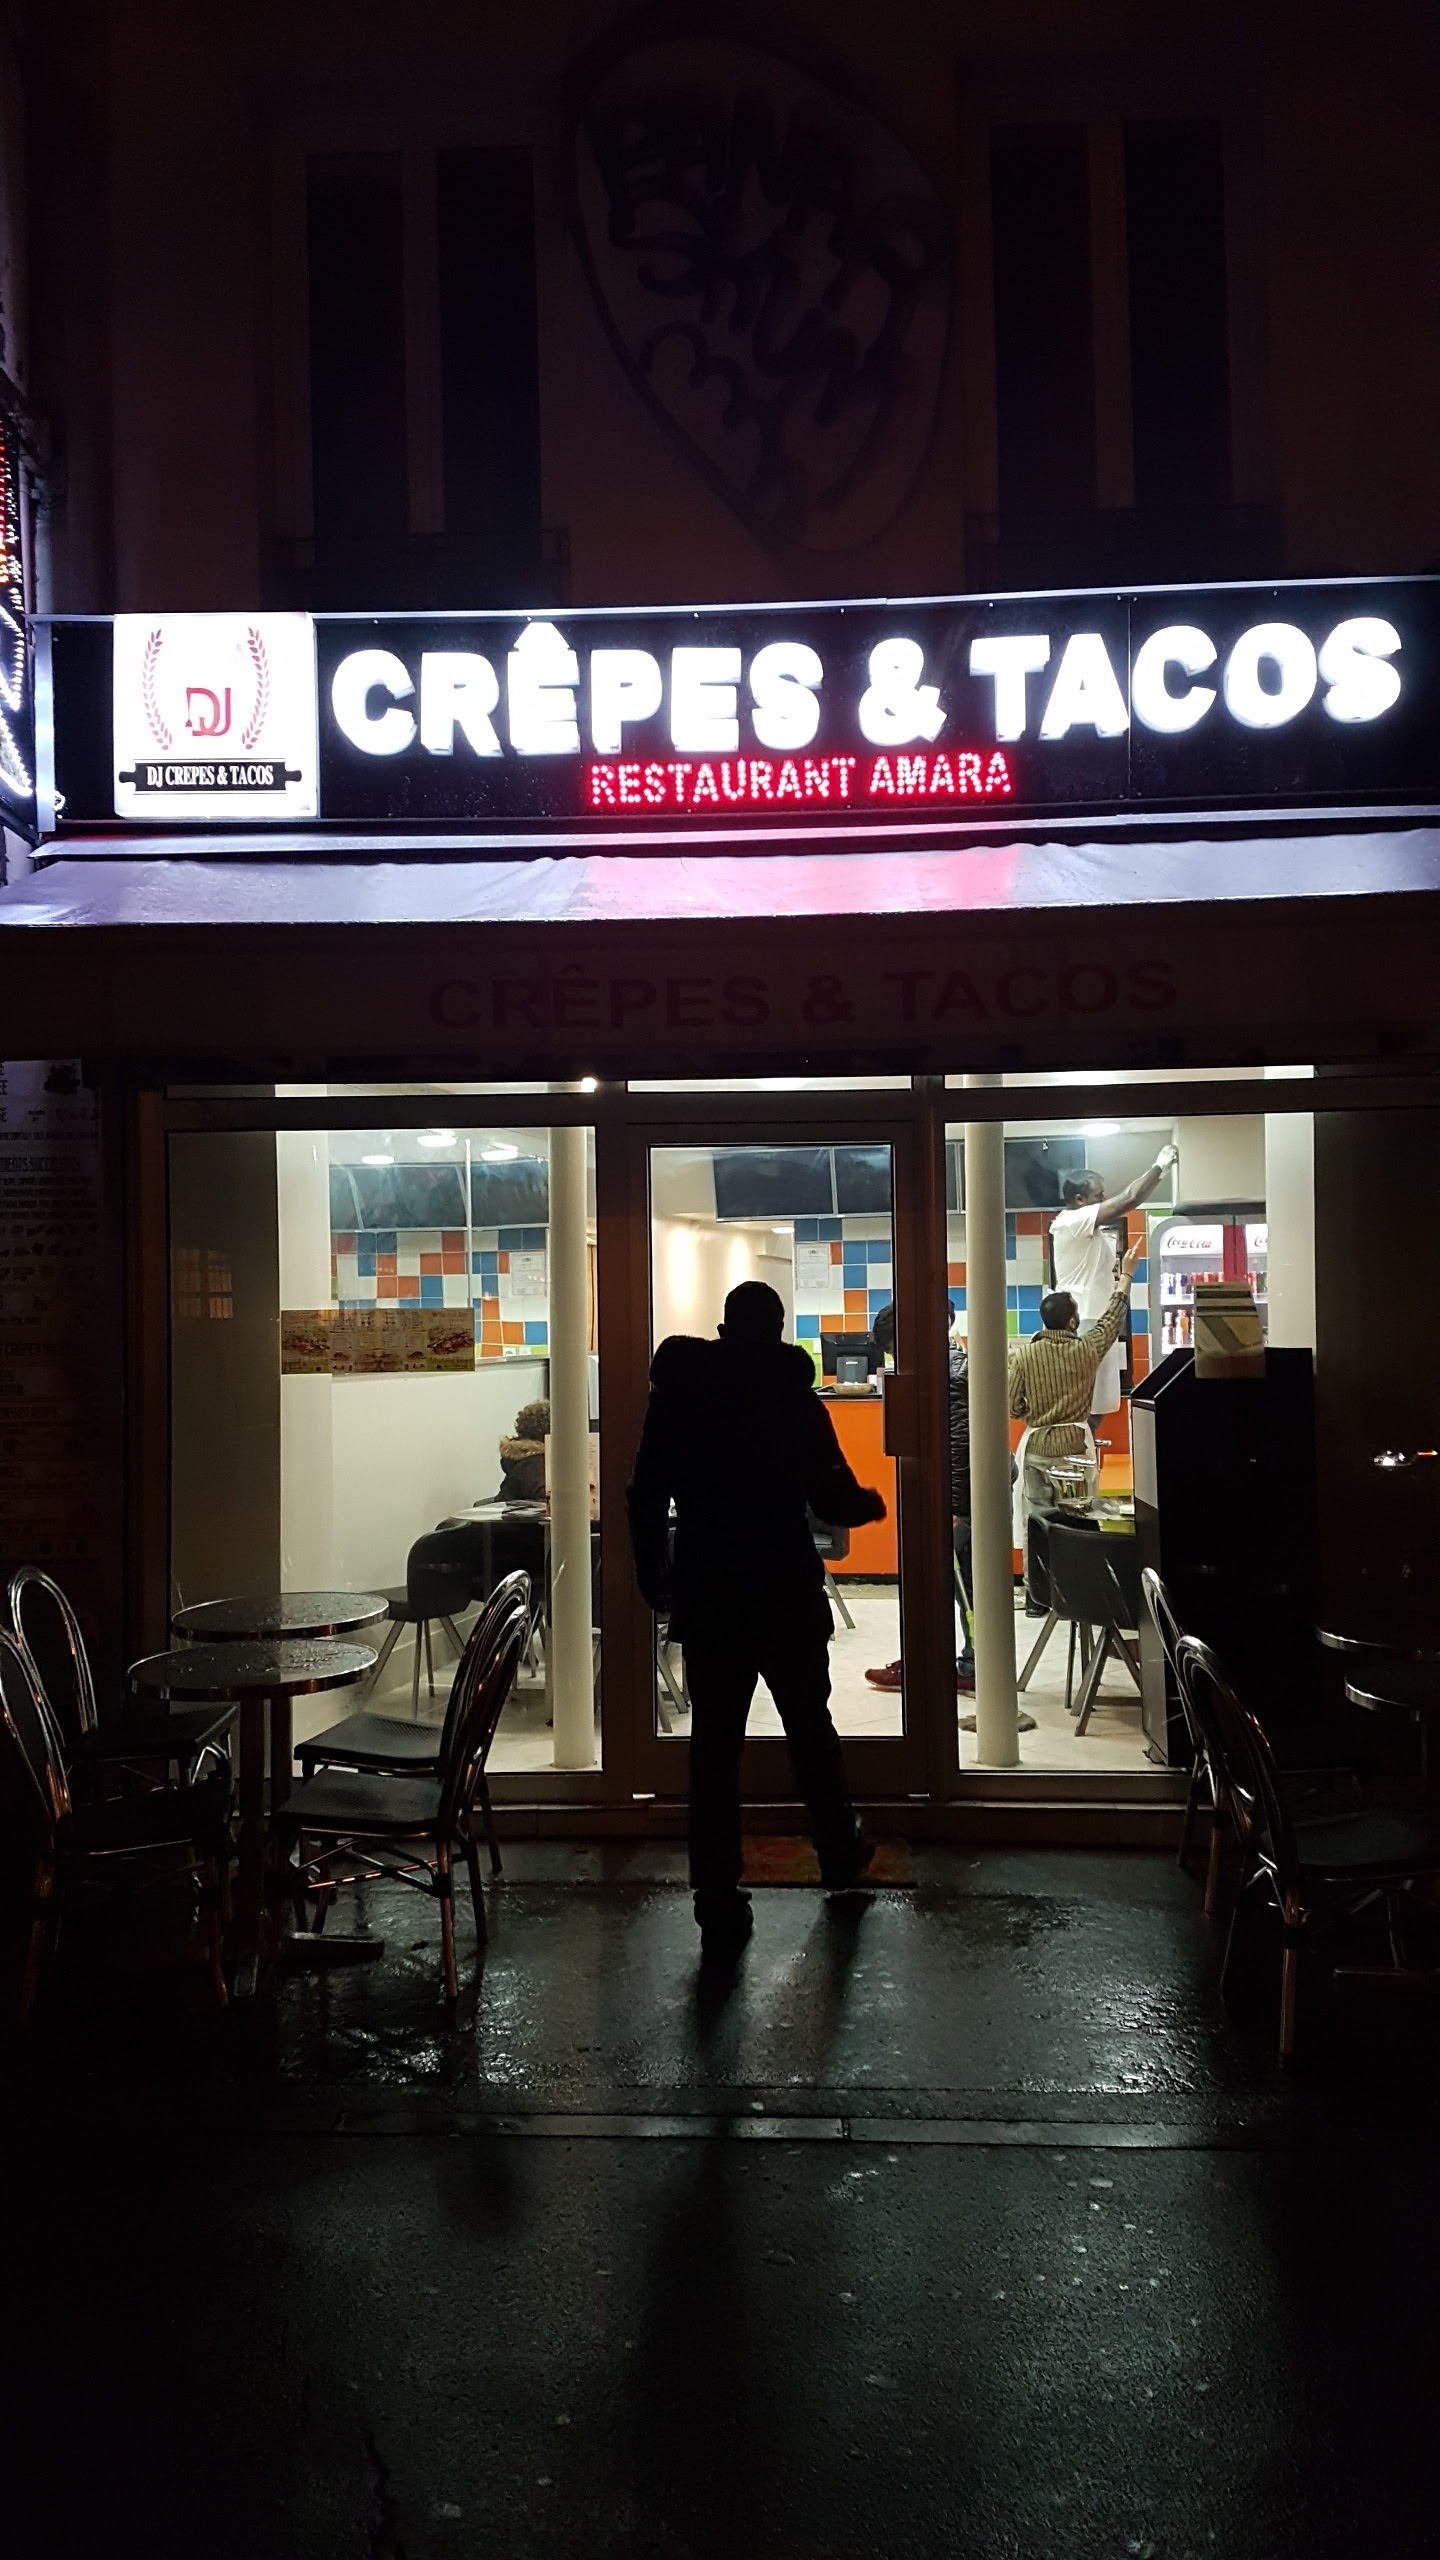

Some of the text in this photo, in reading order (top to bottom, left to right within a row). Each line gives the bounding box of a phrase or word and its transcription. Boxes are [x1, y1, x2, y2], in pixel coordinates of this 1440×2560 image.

[185, 687, 232, 738] DJ
[330, 616, 1404, 759] CRÊPES & TACOS
[147, 764, 274, 787] DJ CREPES & TACOS
[588, 750, 1014, 806] RESTAURANT AMARA
[428, 958, 1177, 1030] CRÊPES & TACOS
[1167, 1235, 1212, 1249] CocaCola
